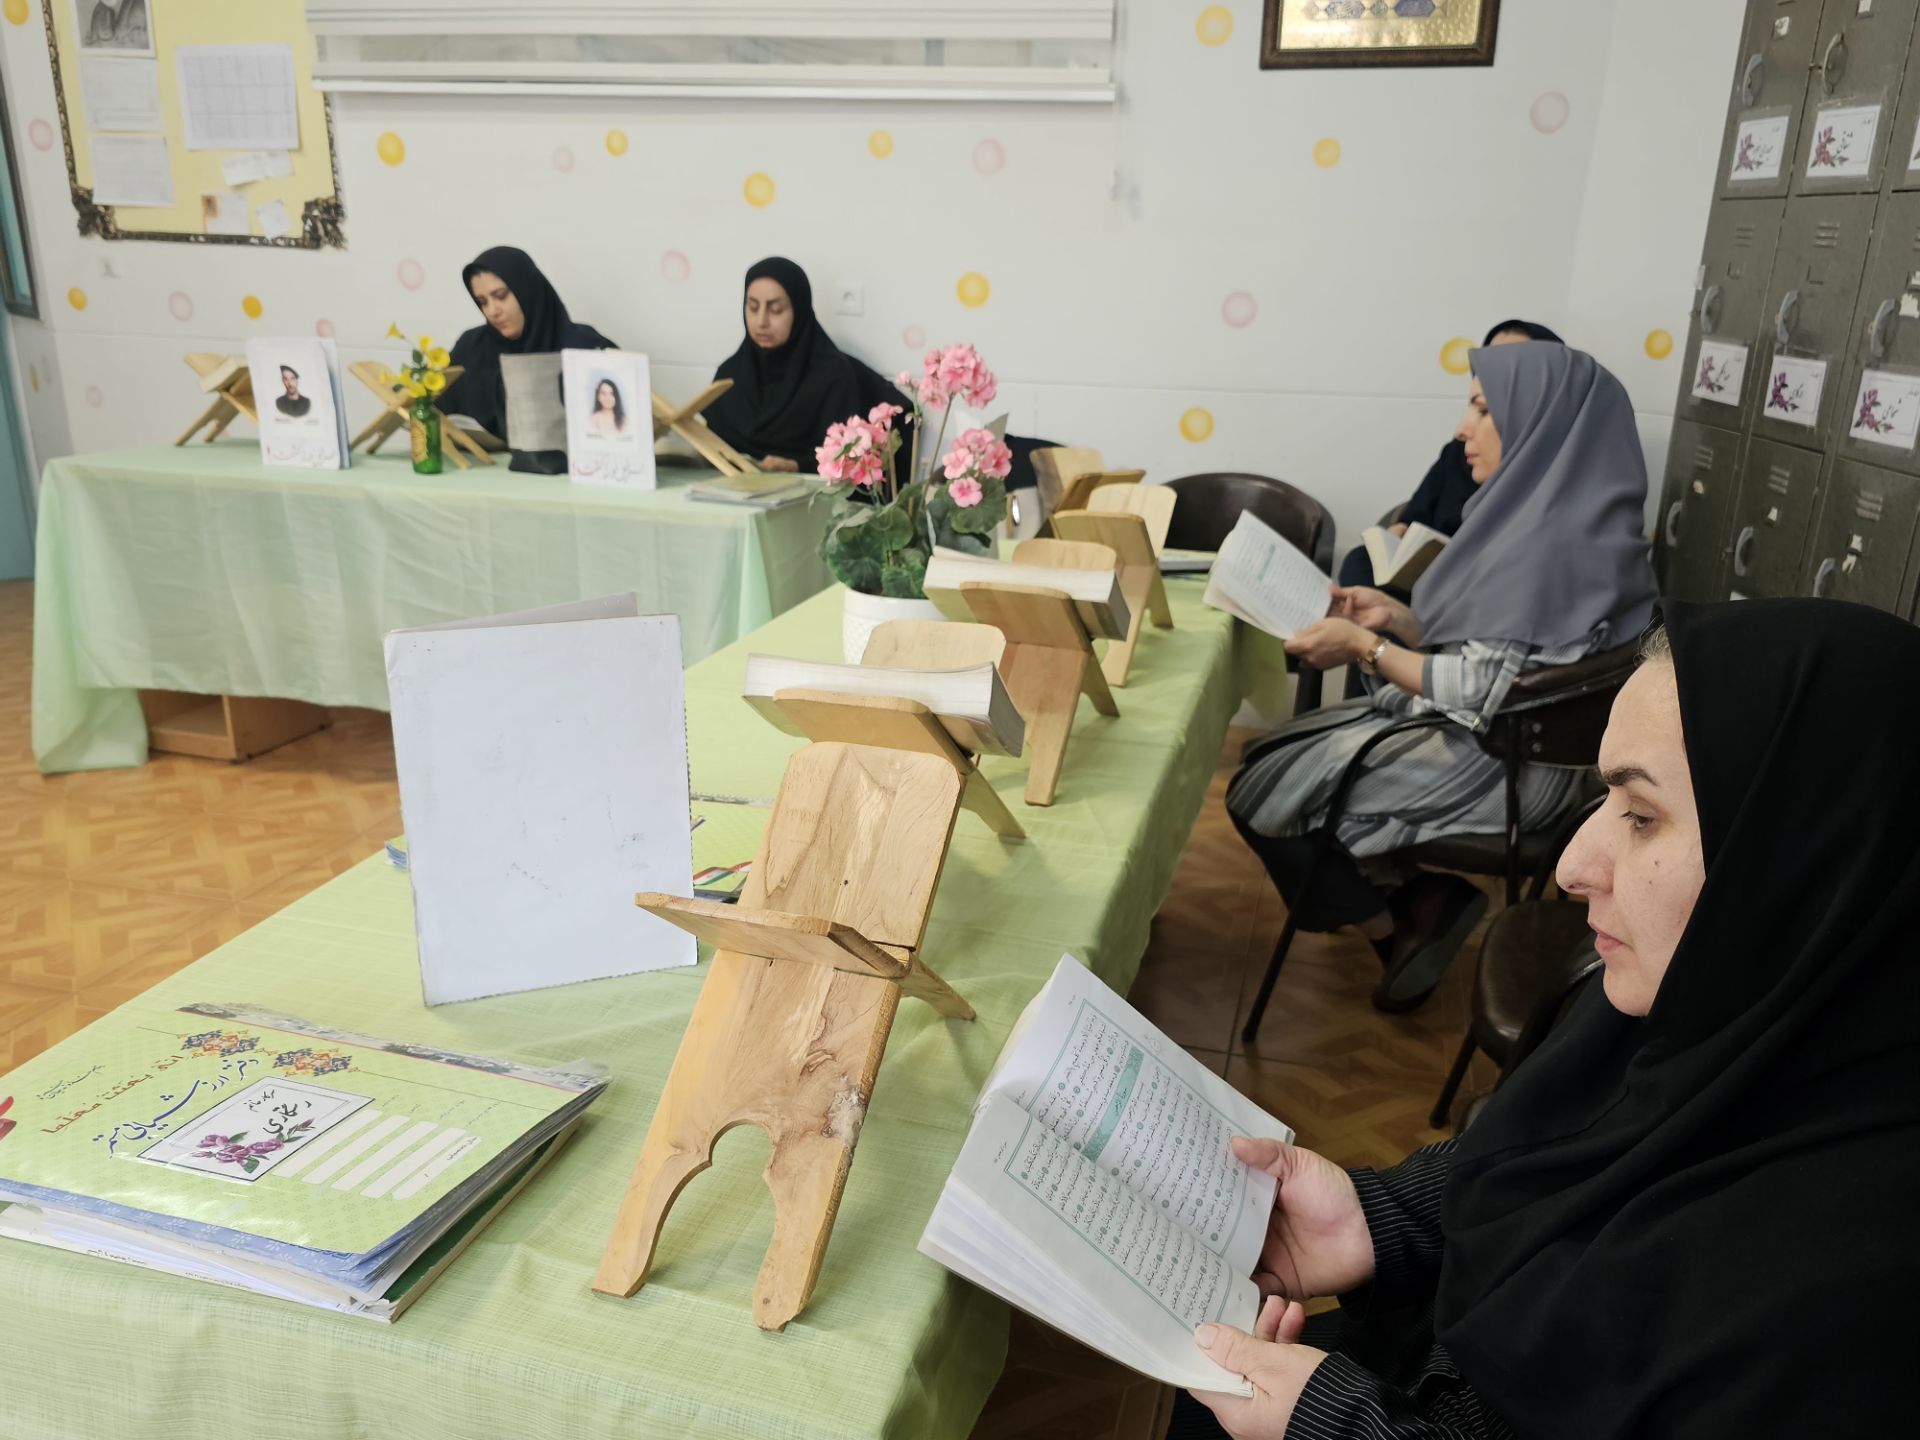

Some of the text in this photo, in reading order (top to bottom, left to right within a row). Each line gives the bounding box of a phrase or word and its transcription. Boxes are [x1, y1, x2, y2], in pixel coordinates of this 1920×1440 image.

[221, 1058, 260, 1081] دفتر
[121, 1074, 231, 1141] ارزشیابی
[92, 1126, 121, 1159] مستمر
